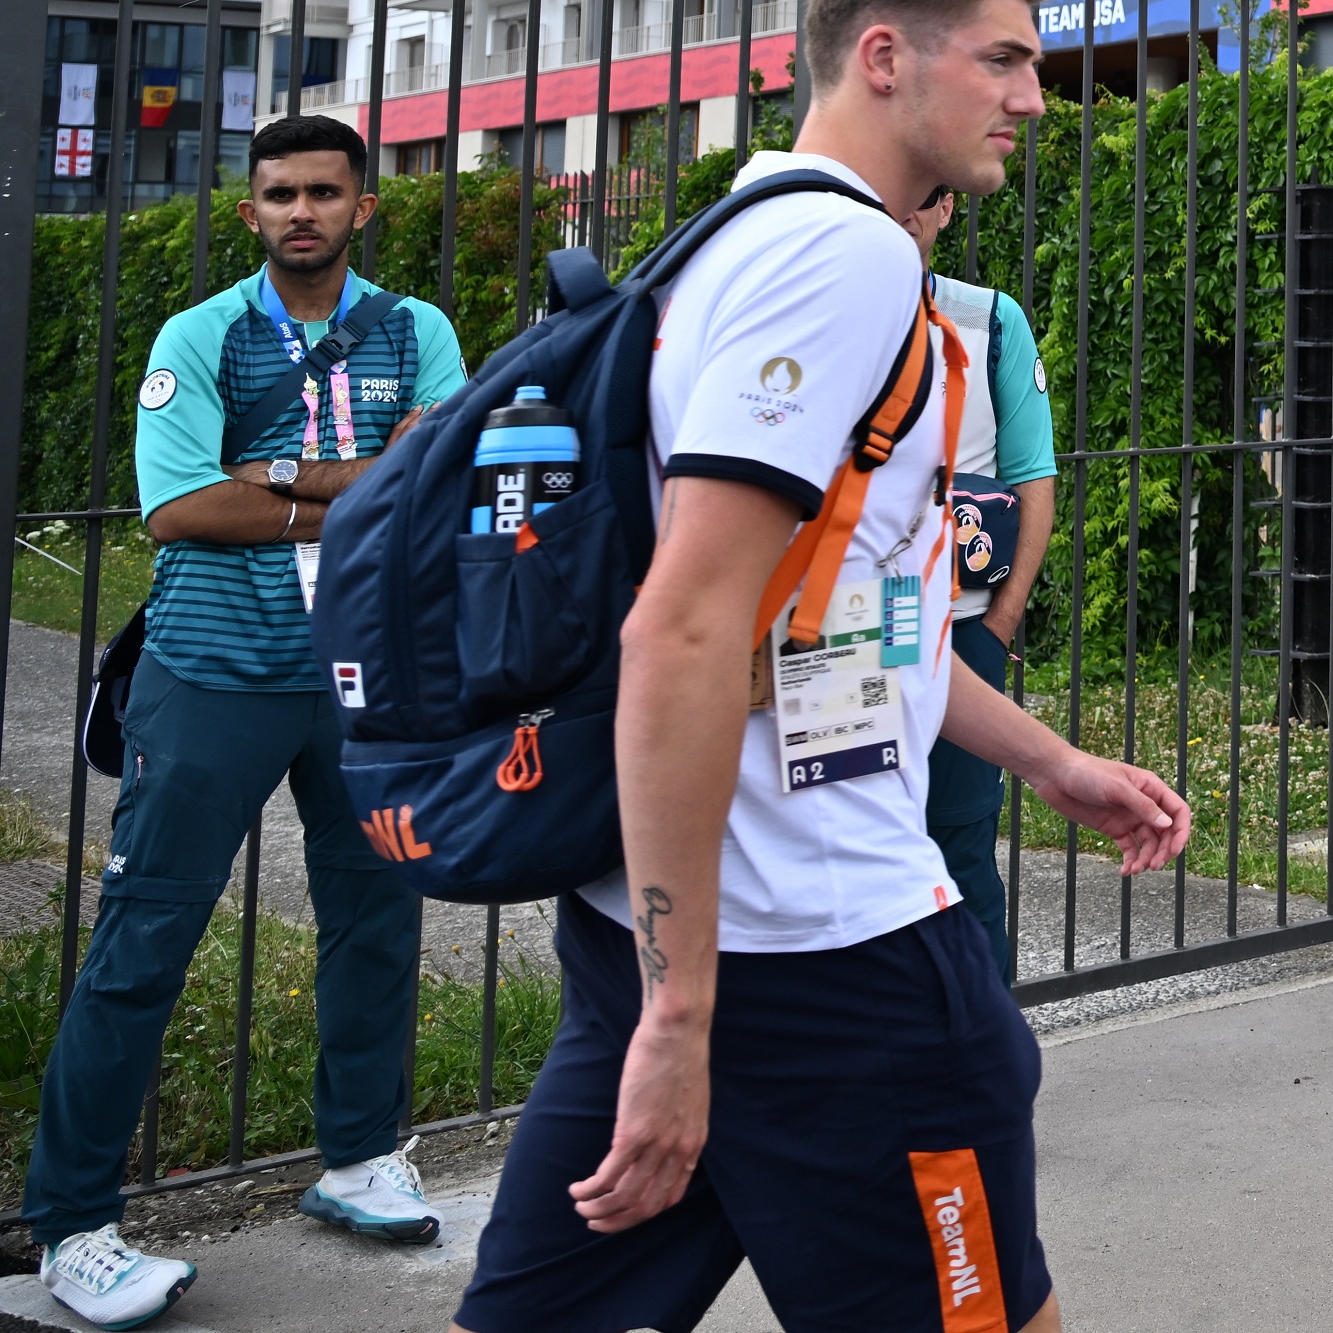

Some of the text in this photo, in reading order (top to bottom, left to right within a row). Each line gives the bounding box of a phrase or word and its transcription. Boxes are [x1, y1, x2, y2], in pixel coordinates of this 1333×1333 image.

[1038, 3, 1084, 34] TEAM
[362, 379, 399, 391] PARIS
[362, 390, 398, 403] 2024
[740, 393, 772, 405] PARIS
[780, 657, 812, 668] Caspar
[792, 766, 806, 785] A
[810, 761, 824, 780] 2
[934, 1186, 982, 1307] TeamNL
